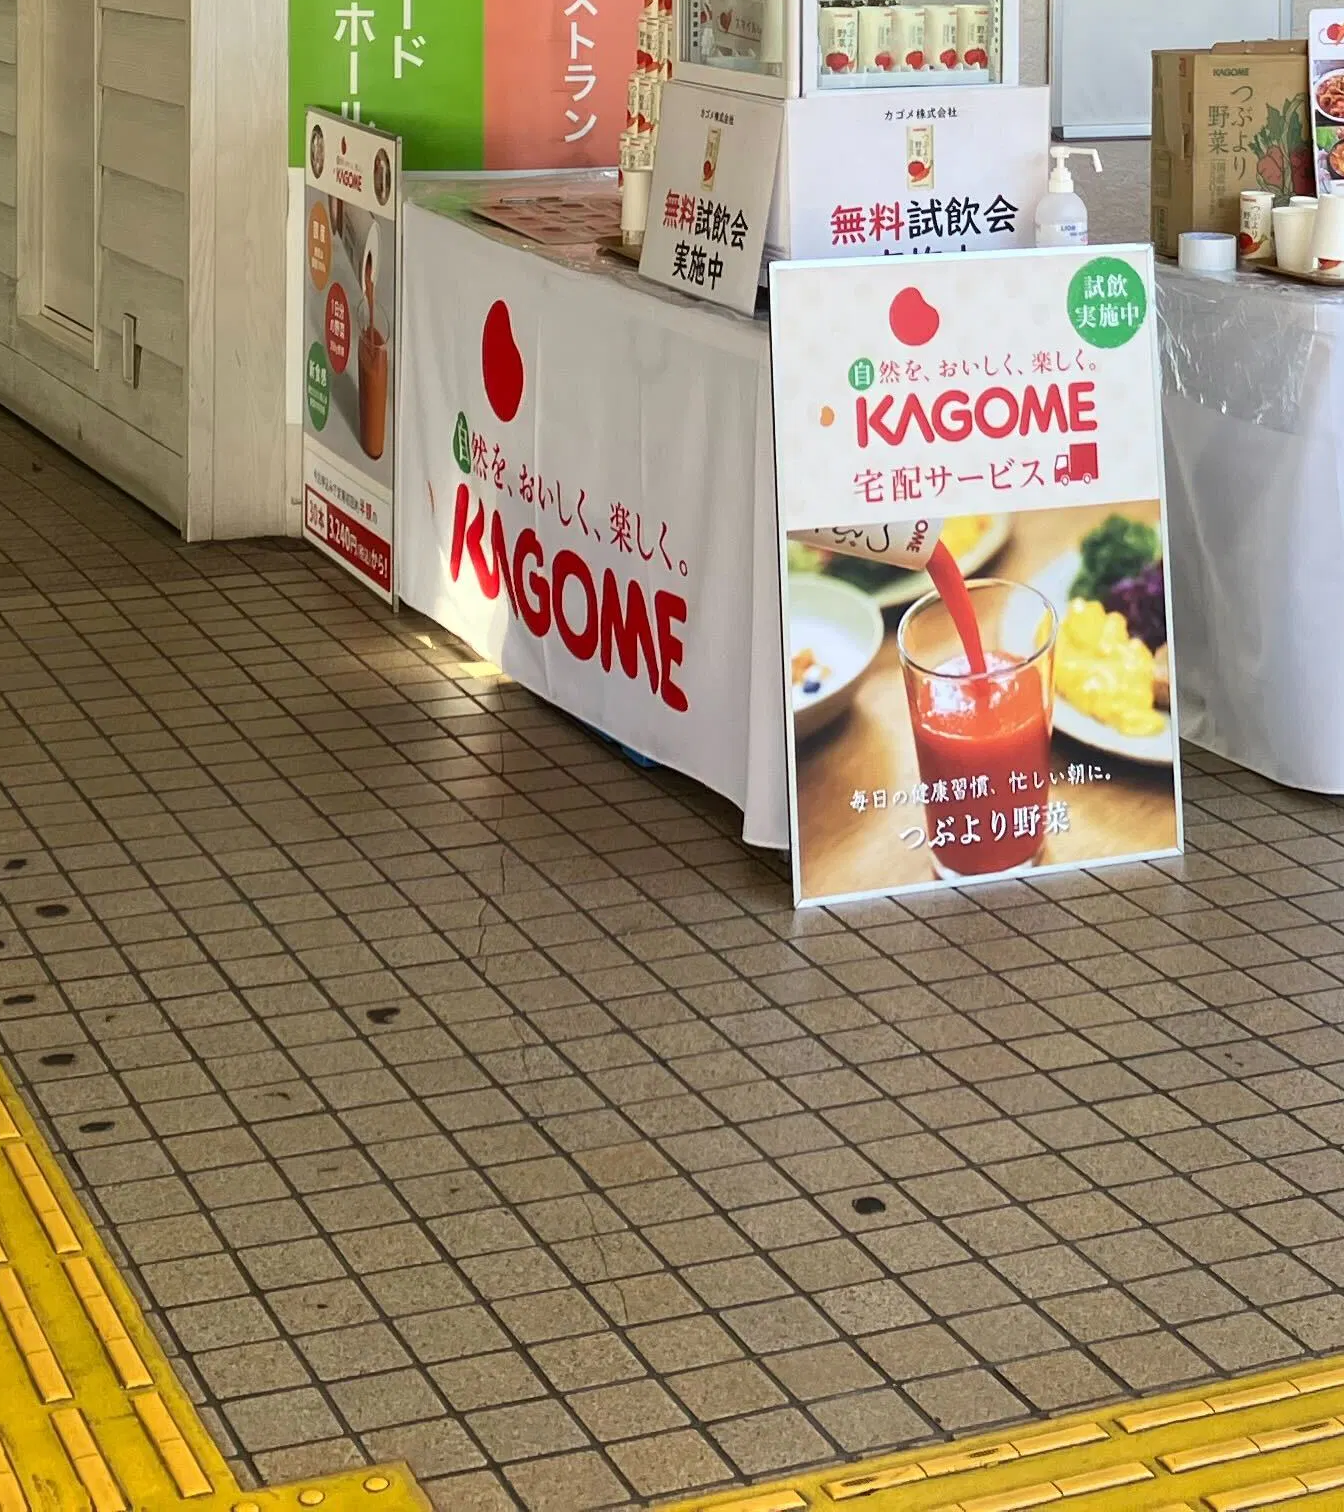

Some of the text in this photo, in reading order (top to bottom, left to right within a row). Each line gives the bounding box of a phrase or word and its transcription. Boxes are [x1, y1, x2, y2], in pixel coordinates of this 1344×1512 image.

[1212, 68, 1250, 77] KAGOME
[884, 107, 958, 121] カゴメ株式会社
[1208, 105, 1230, 154] 野菜
[1231, 85, 1254, 180] つぶより
[663, 187, 749, 253] 無料試飲会
[830, 193, 1020, 247] 無料試飲会
[672, 242, 724, 293] 実施中
[1083, 273, 1130, 301] 試飲
[1074, 301, 1141, 329] 実施中
[856, 381, 1098, 448] KAGOME
[853, 460, 1046, 504] 宅配サービス
[450, 483, 688, 712] KAGOME
[899, 800, 1071, 852] つぶより野菜
